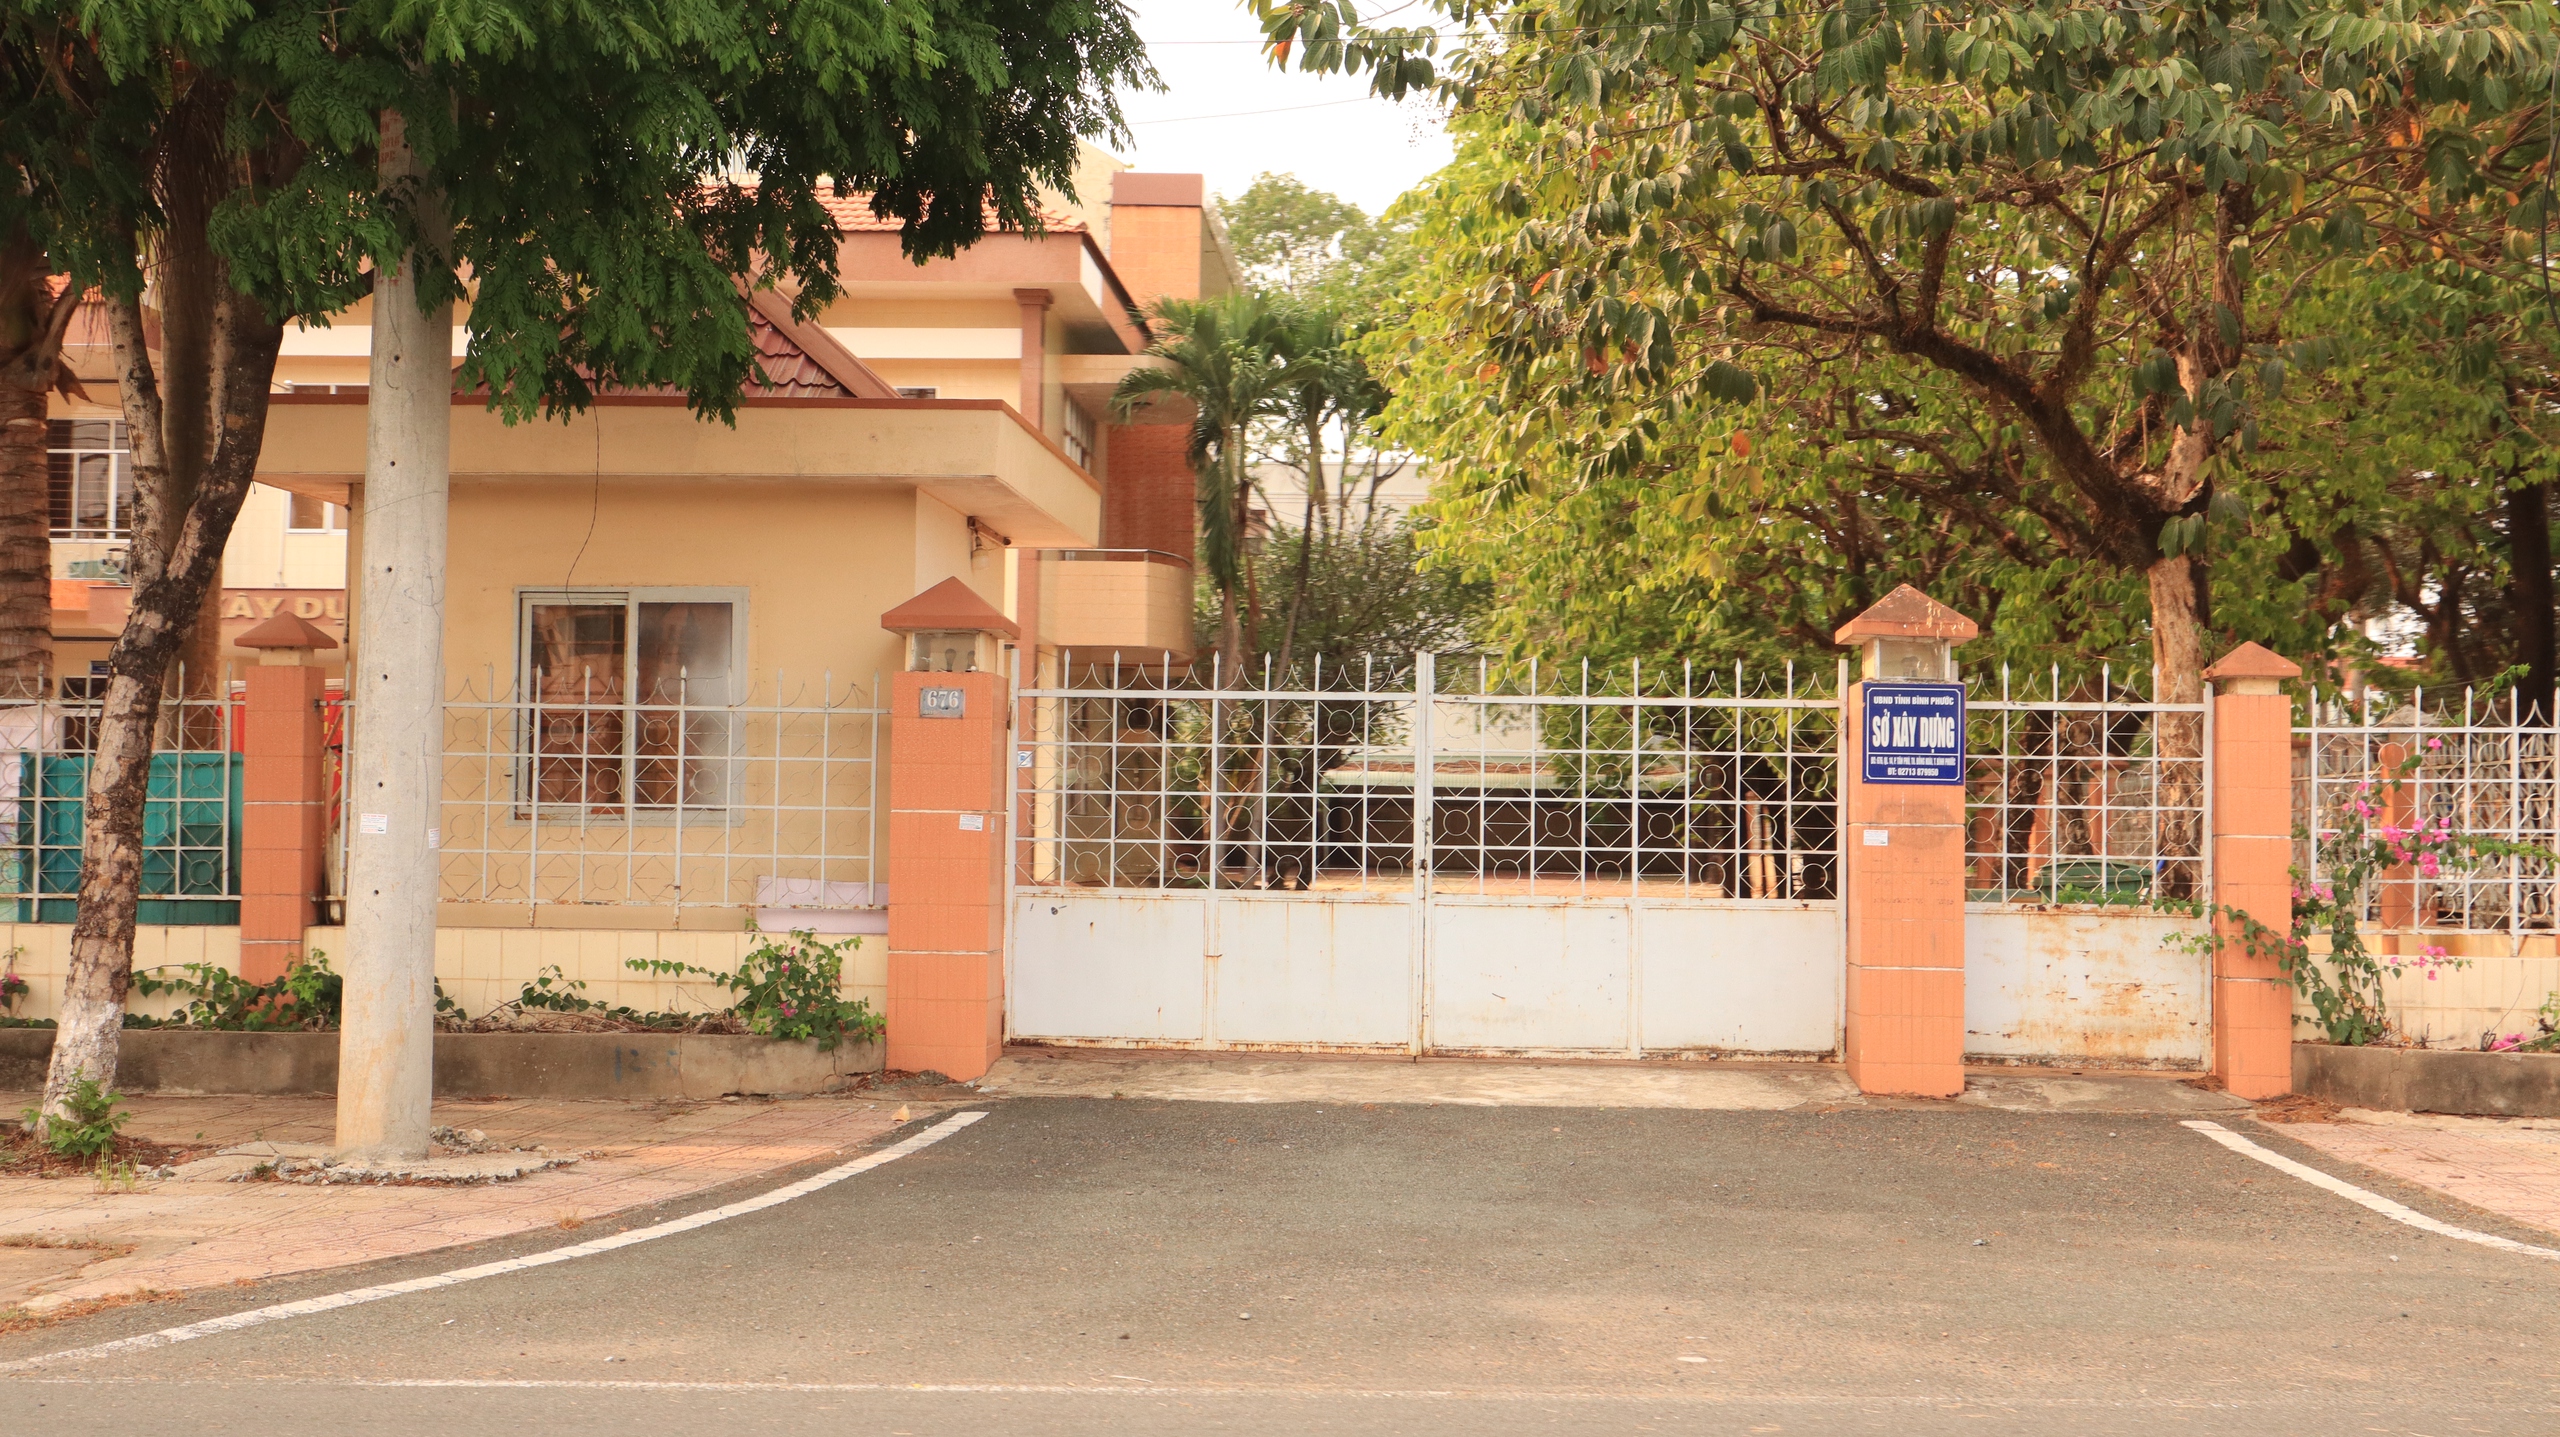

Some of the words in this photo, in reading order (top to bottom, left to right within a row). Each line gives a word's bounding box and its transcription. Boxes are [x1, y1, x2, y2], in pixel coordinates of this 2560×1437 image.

[928, 690, 959, 708] 676
[1873, 695, 1893, 704] UBND
[1912, 695, 1929, 705] BÌNH
[1872, 708, 1890, 748] SỞ
[1892, 711, 1917, 748] XÂY
[1919, 712, 1955, 754] DỰNG
[1887, 767, 1897, 776] ĐT:
[1898, 768, 1916, 776] 02713
[1917, 768, 1939, 776] 879950
